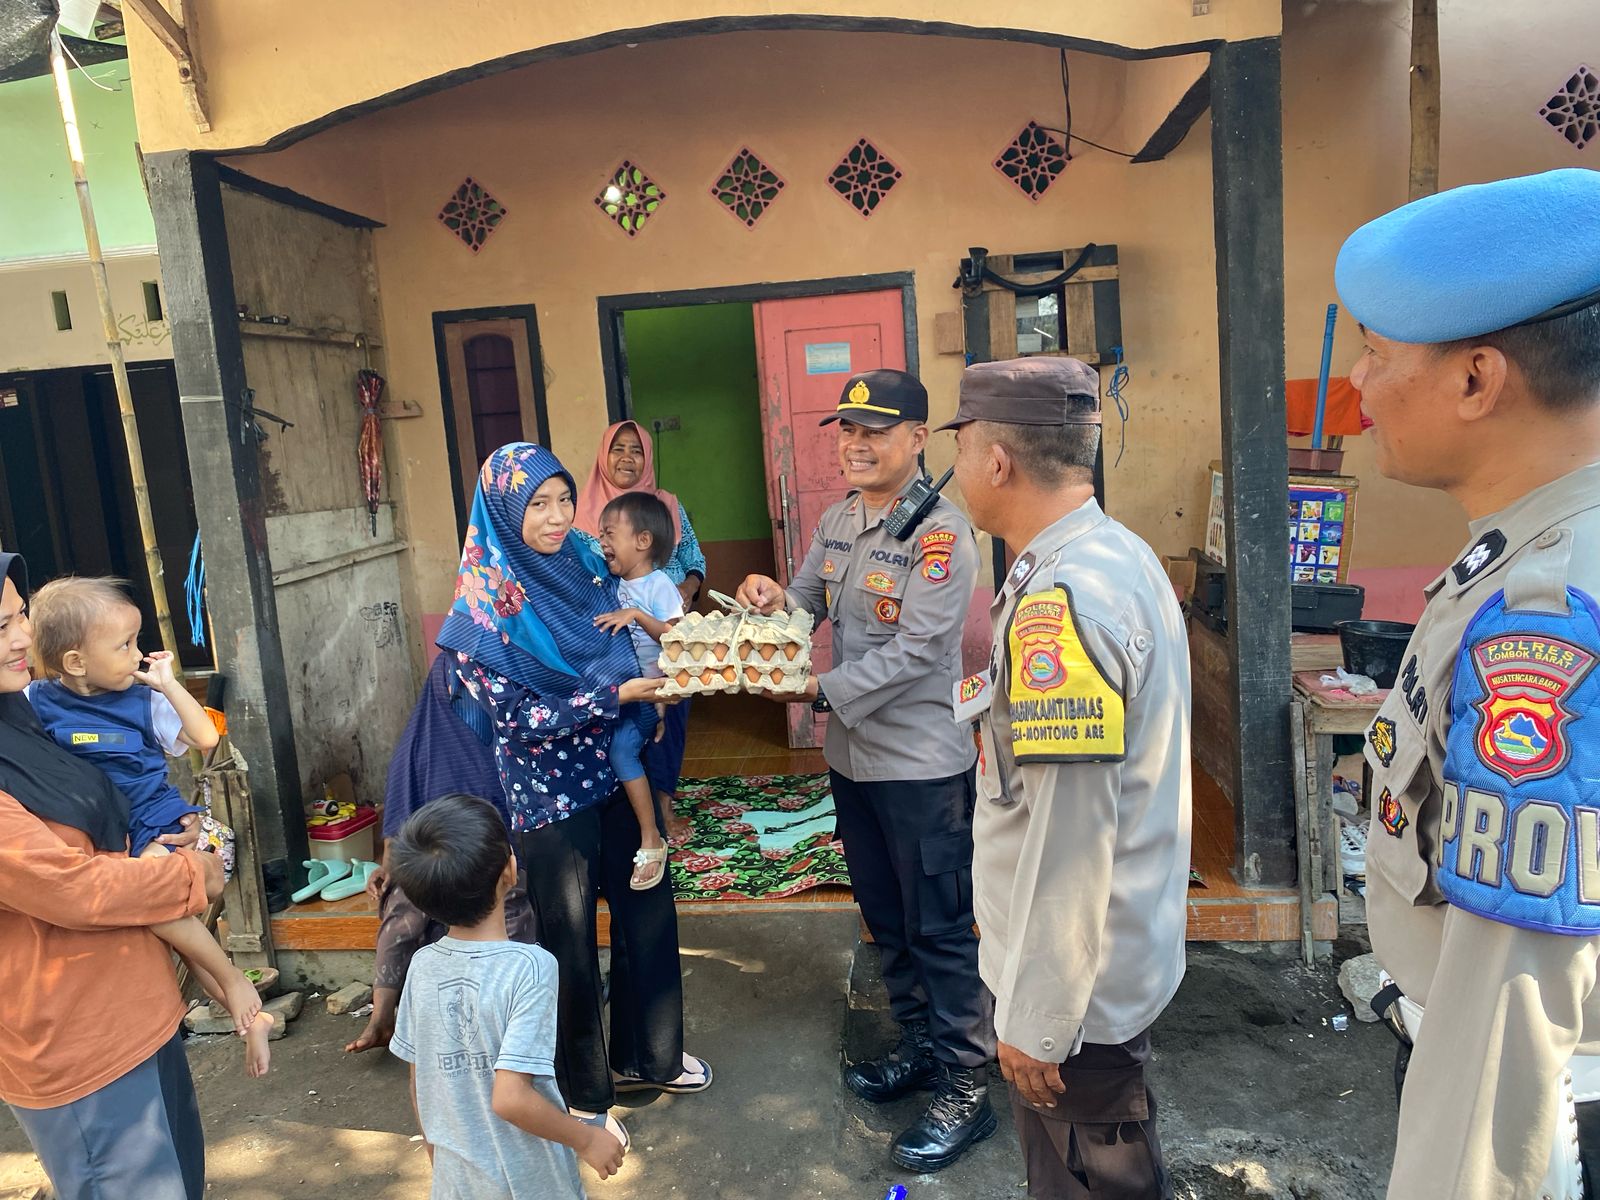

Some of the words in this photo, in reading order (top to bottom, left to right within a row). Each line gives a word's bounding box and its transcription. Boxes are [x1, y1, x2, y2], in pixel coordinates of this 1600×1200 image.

[1487, 640, 1576, 663] POLRES
[1489, 650, 1530, 663] LOMBOK
[1535, 651, 1573, 670] BARAT
[1402, 654, 1429, 726] POLRI
[1084, 723, 1105, 740] ARE
